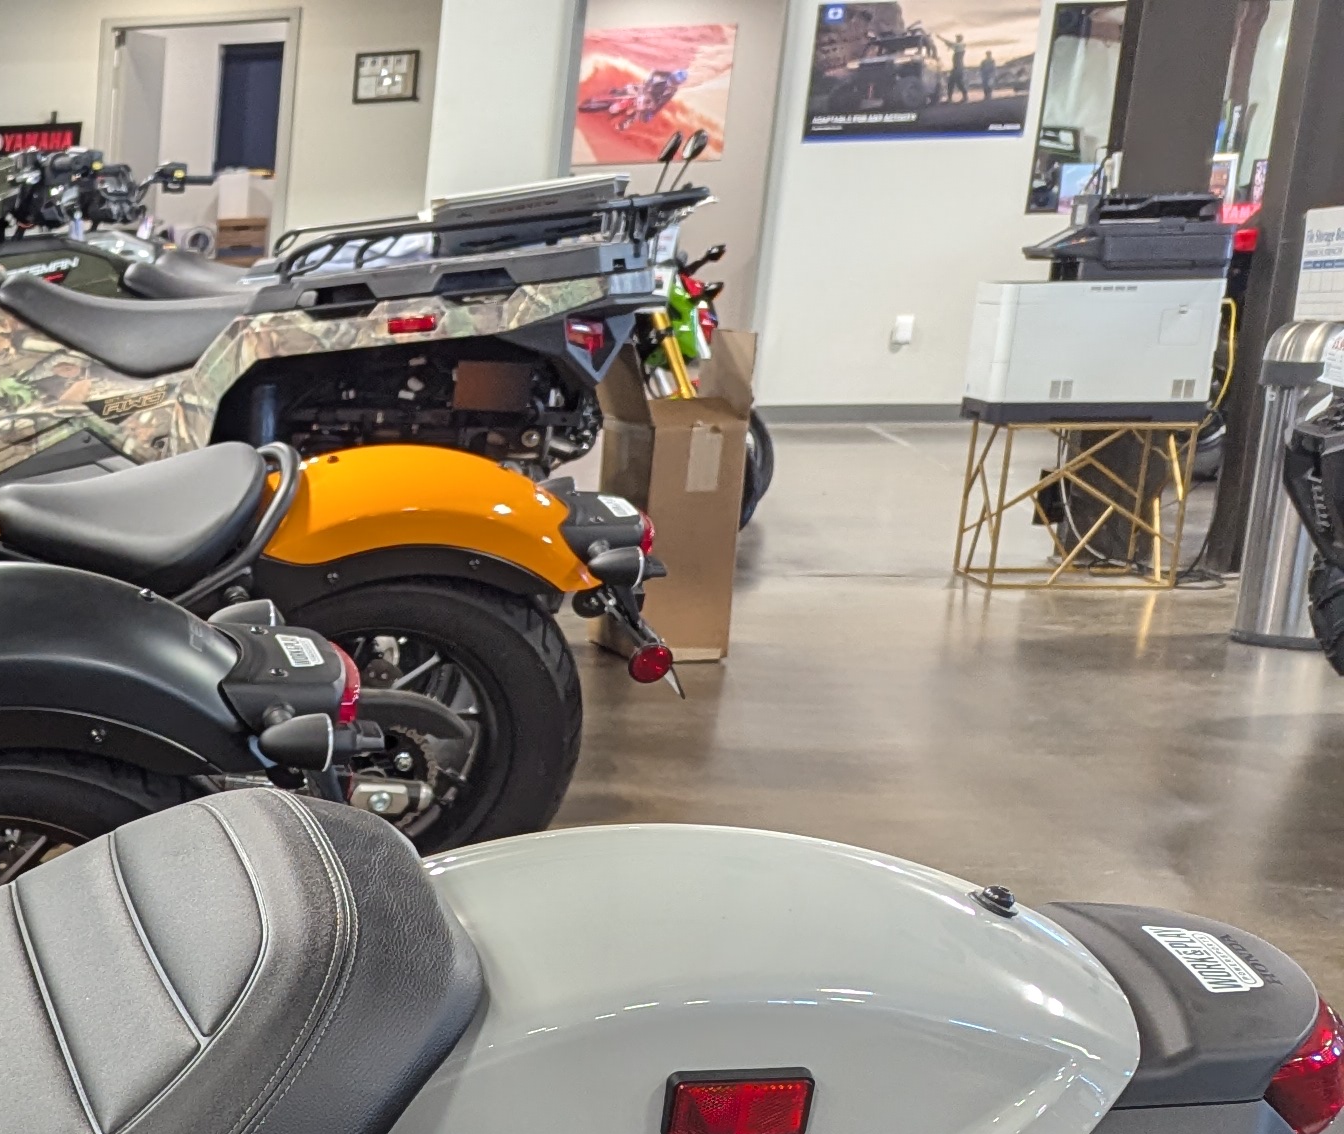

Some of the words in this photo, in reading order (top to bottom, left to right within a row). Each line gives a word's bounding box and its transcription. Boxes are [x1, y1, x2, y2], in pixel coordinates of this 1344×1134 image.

[3, 131, 73, 152] YAMAHA
[1149, 926, 1244, 990] WORK&PLAY
[1220, 933, 1284, 986] HONDA
